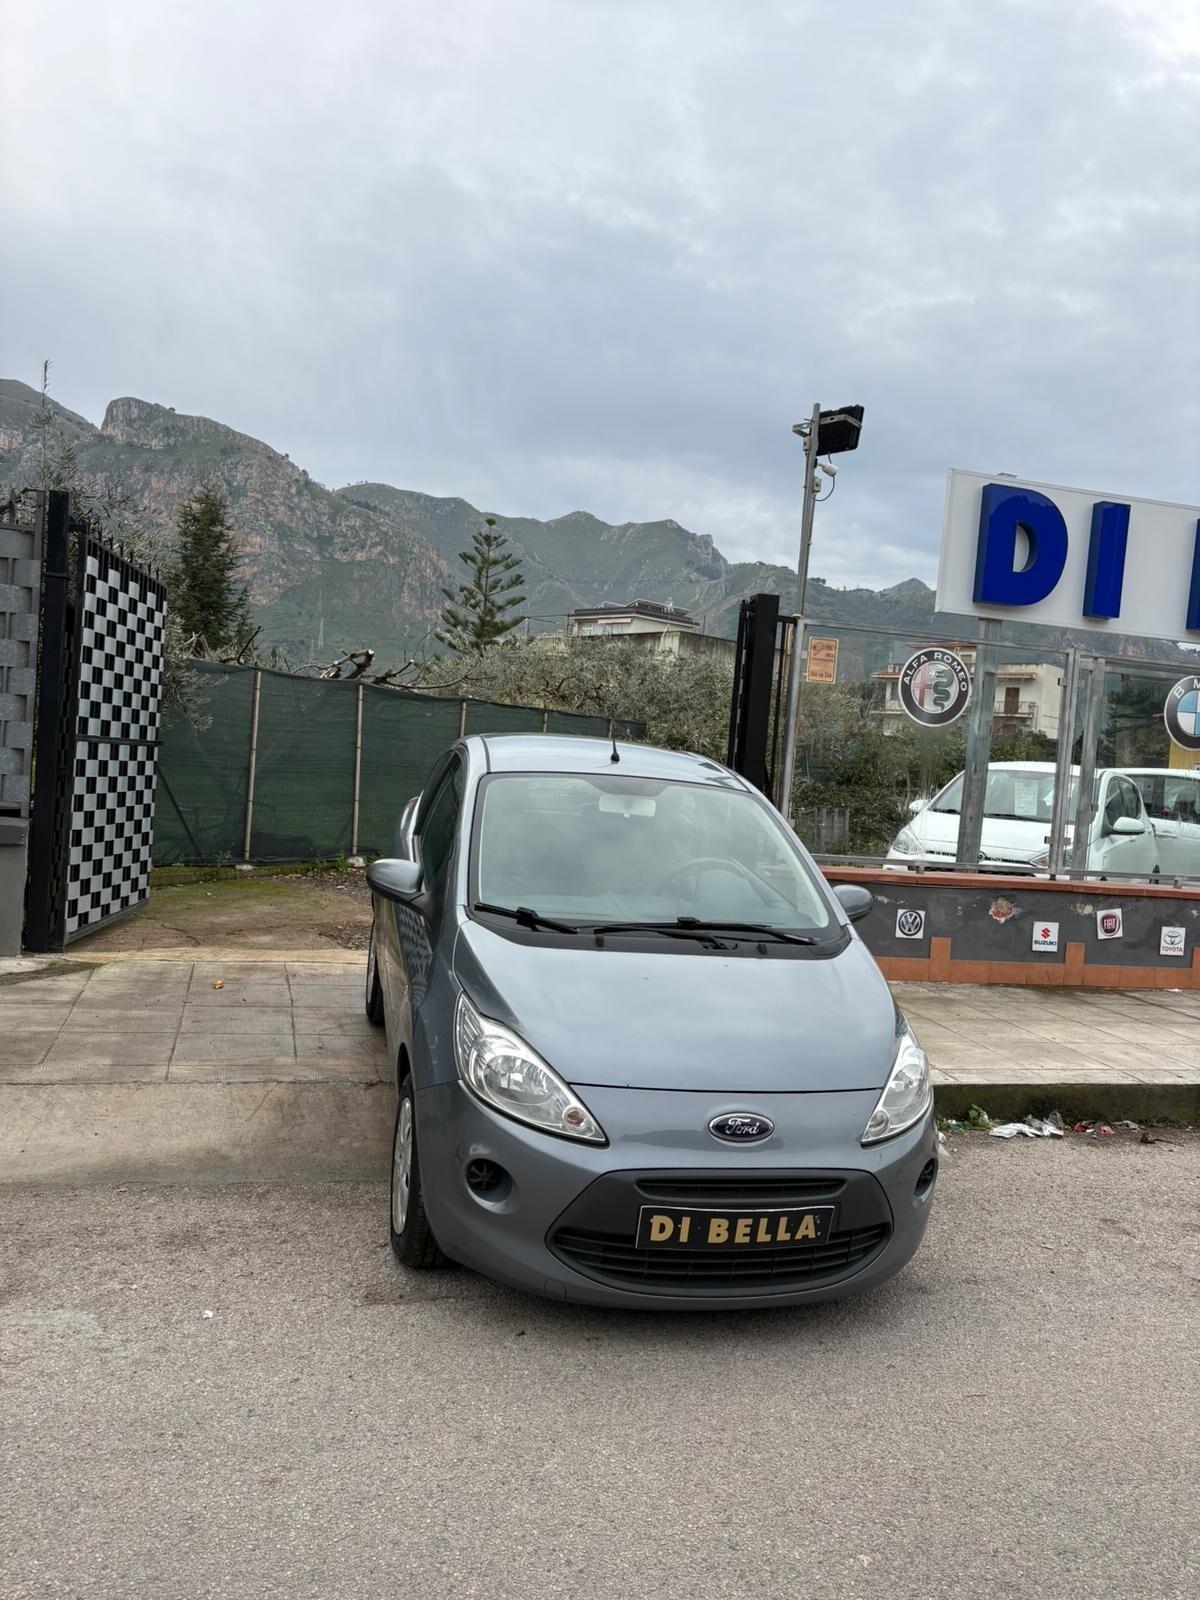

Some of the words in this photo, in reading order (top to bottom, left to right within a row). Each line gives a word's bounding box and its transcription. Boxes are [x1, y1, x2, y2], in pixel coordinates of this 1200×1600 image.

[973, 483, 1131, 619] DI
[903, 654, 929, 685] ALFA
[933, 652, 967, 692] ROMEO
[1173, 678, 1200, 699] BM
[1103, 917, 1116, 930] FIAT
[1161, 945, 1183, 953] TOYOTA
[725, 1117, 760, 1135] Ford
[650, 1214, 691, 1243] DI
[707, 1214, 816, 1244] BELLA
